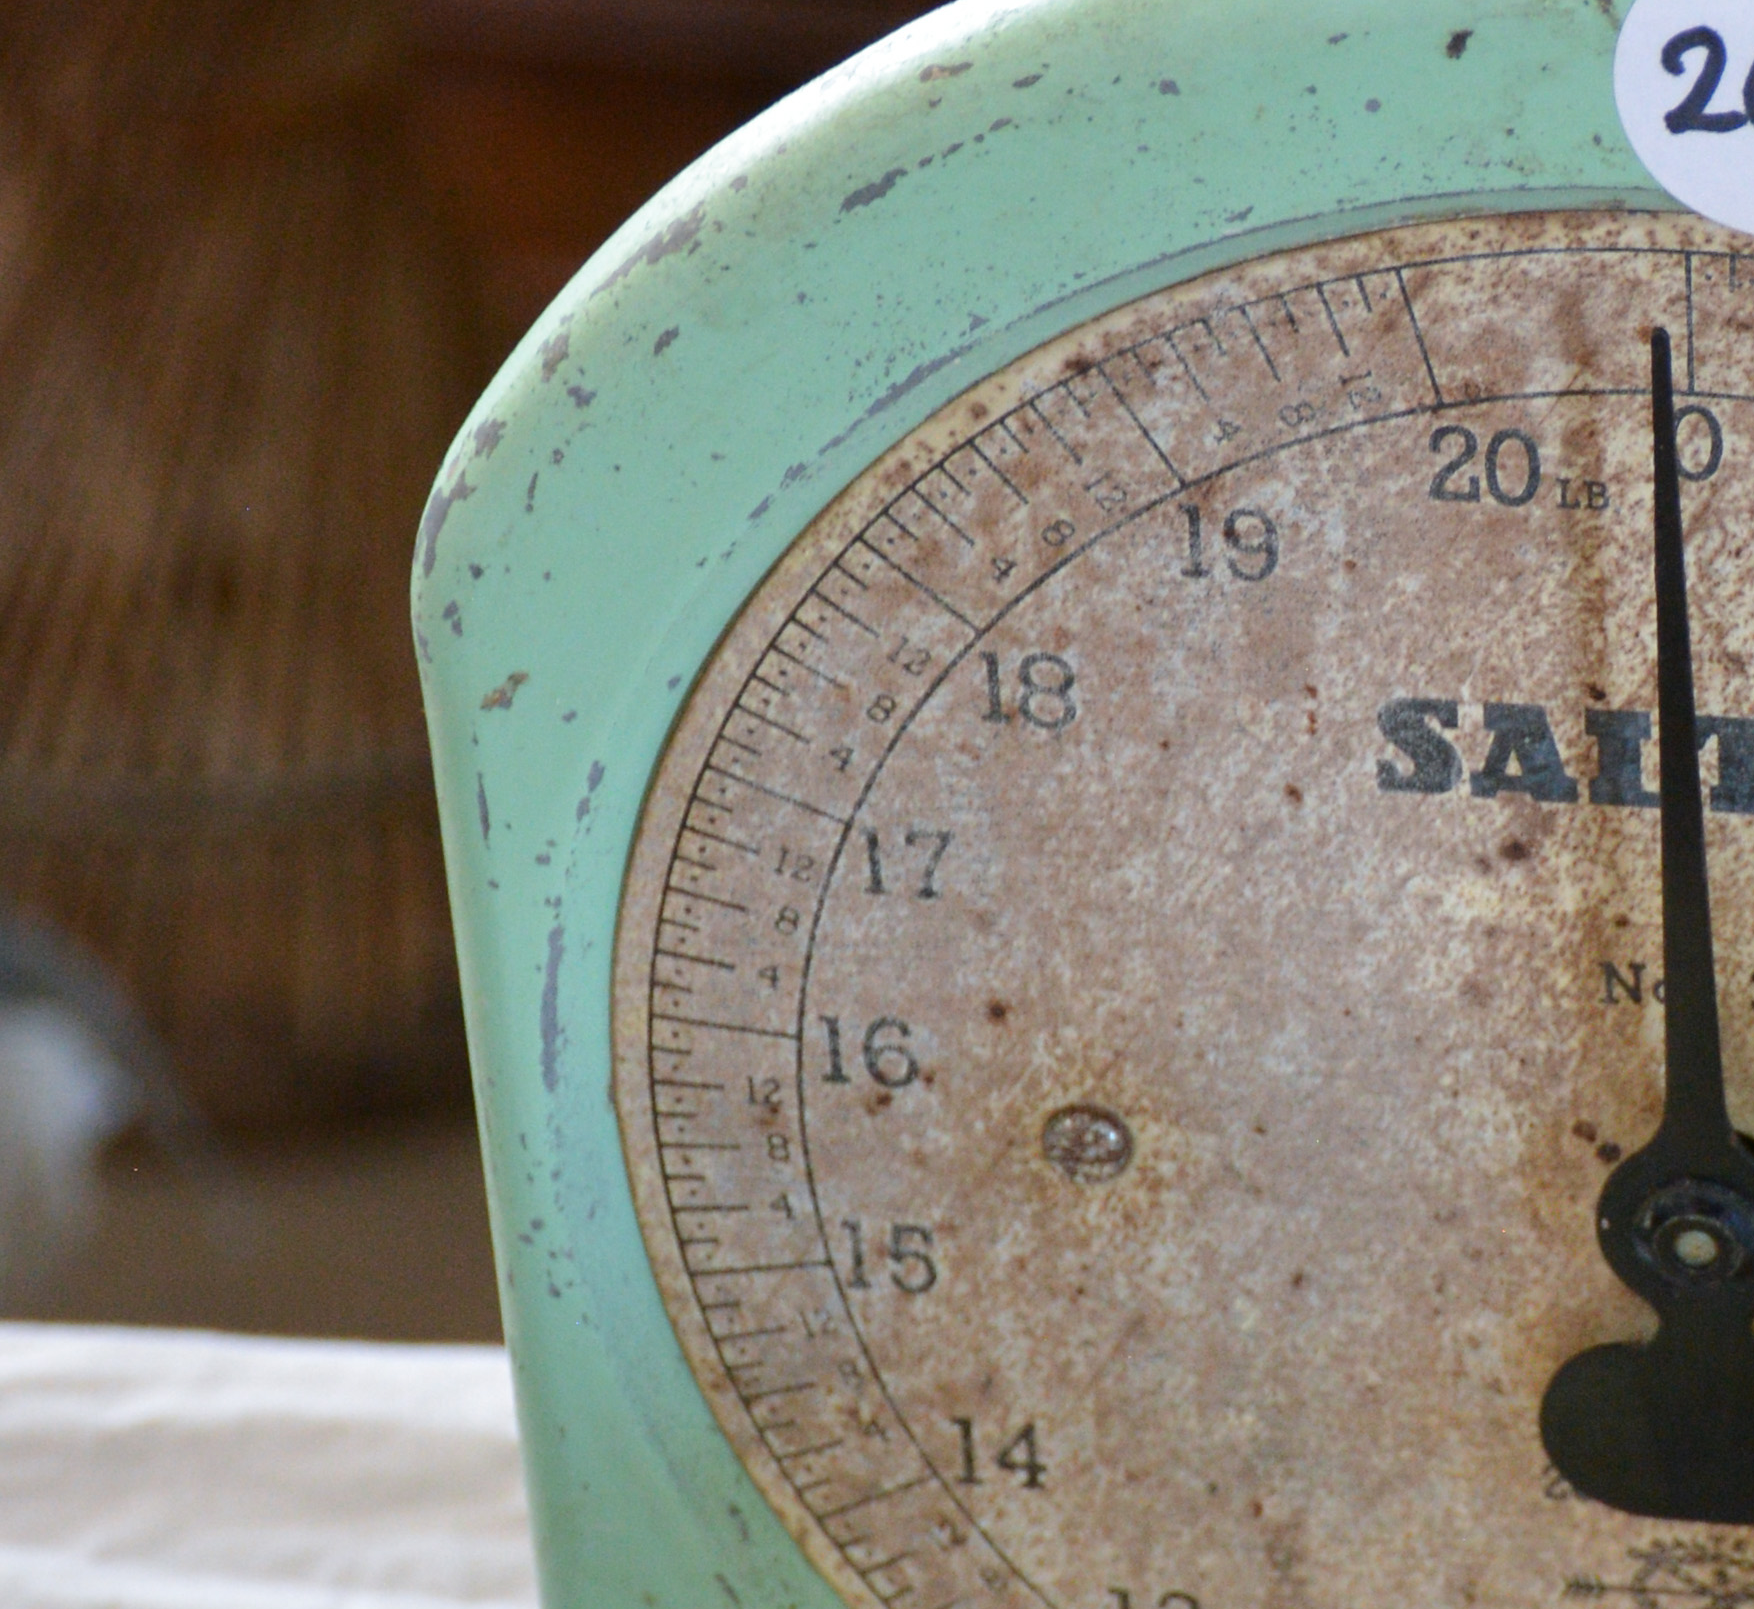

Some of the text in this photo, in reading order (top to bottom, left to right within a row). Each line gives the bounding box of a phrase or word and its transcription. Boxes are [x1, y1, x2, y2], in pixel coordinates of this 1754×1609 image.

[1213, 417, 1242, 446] 4
[1278, 400, 1316, 428] 8
[1672, 404, 1724, 483] 0
[1427, 424, 1611, 510] 20 LB
[1083, 471, 1128, 513] 12
[1040, 518, 1077, 548] 8
[1178, 501, 1280, 583] 19
[991, 555, 1018, 583] 4
[886, 636, 933, 677] 12
[978, 651, 1078, 730] 18
[865, 693, 898, 725] 8
[828, 746, 855, 774] 4
[771, 846, 816, 883] 12
[859, 826, 956, 900] 17
[773, 905, 800, 936] 8
[757, 964, 780, 992] 4
[817, 1013, 920, 1090] 16
[746, 1075, 783, 1110] 12
[765, 1132, 791, 1164] 8
[768, 1192, 796, 1221] 4
[839, 1217, 938, 1295] 15
[949, 1416, 1048, 1490] 14
